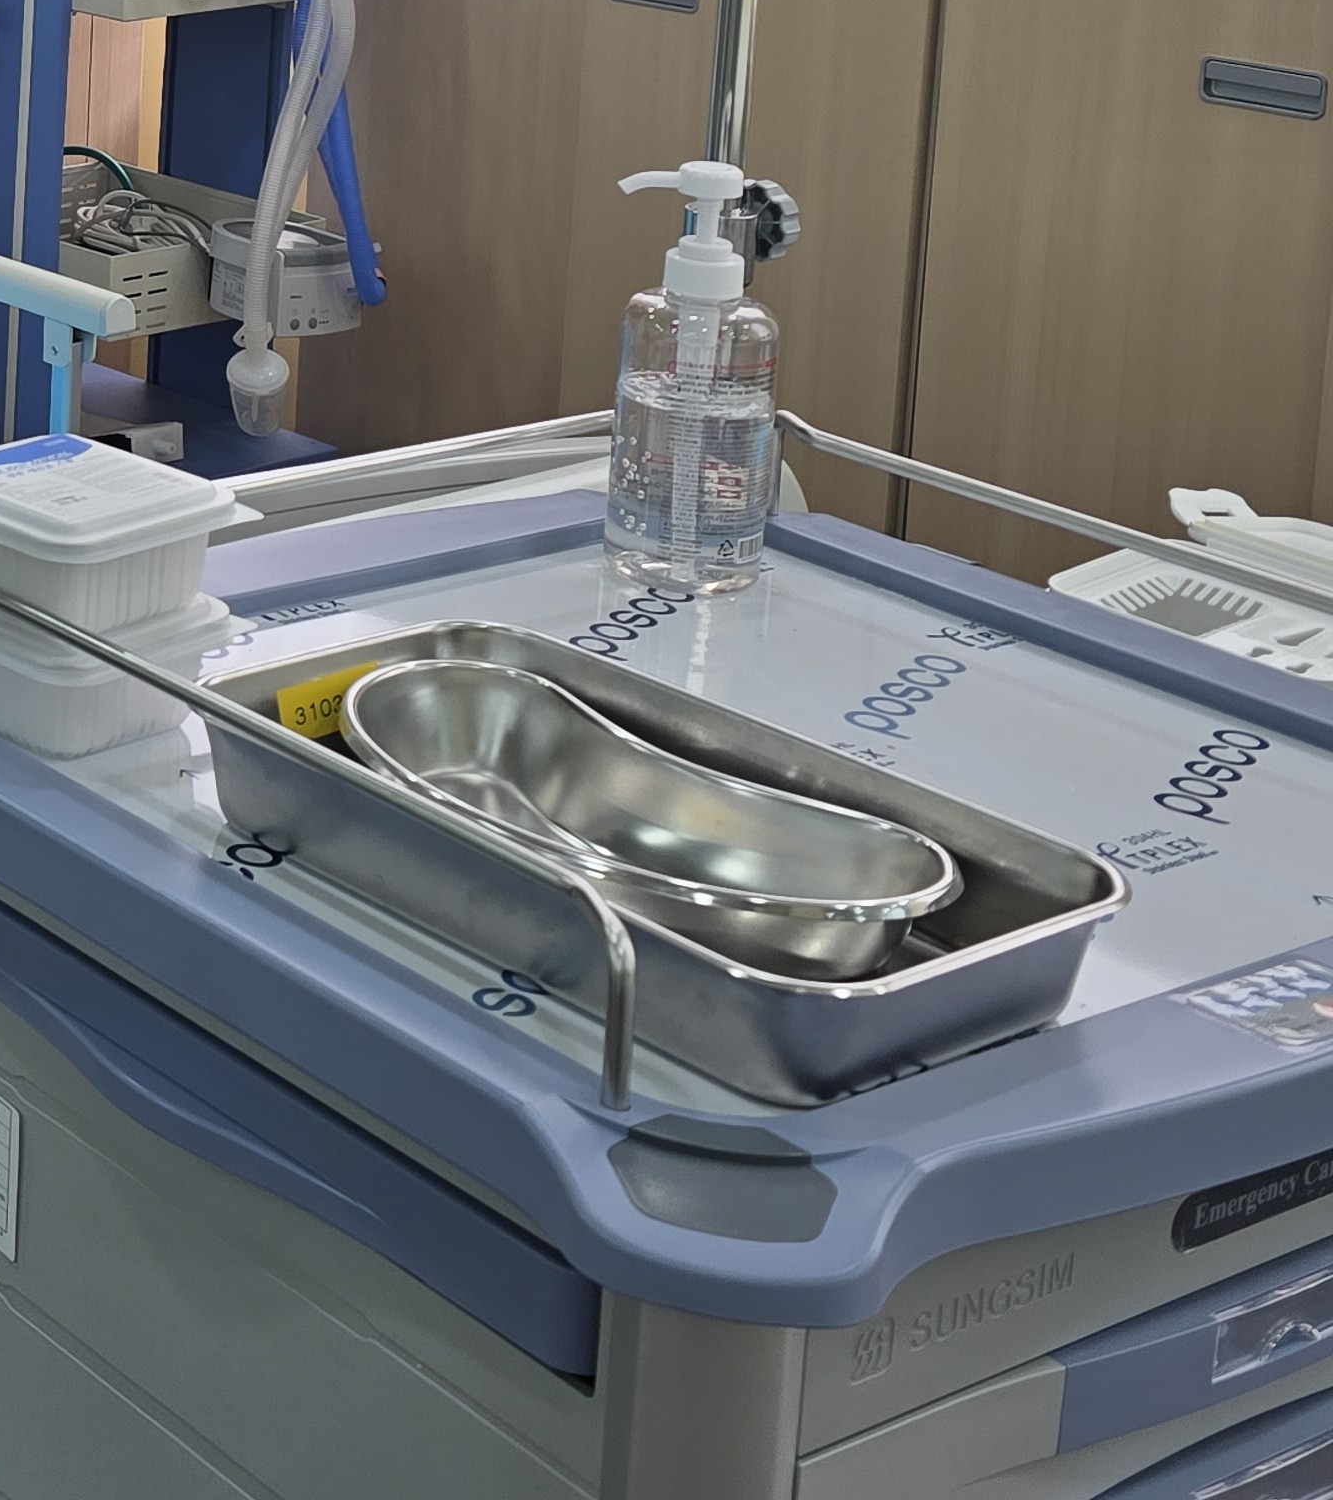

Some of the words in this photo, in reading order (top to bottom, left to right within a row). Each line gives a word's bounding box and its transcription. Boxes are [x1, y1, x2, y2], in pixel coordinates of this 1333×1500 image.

[843, 654, 968, 741] posco
[1153, 729, 1271, 825] posco
[1193, 1173, 1300, 1229] Emergency
[910, 1250, 1076, 1349] SUNGSIM
